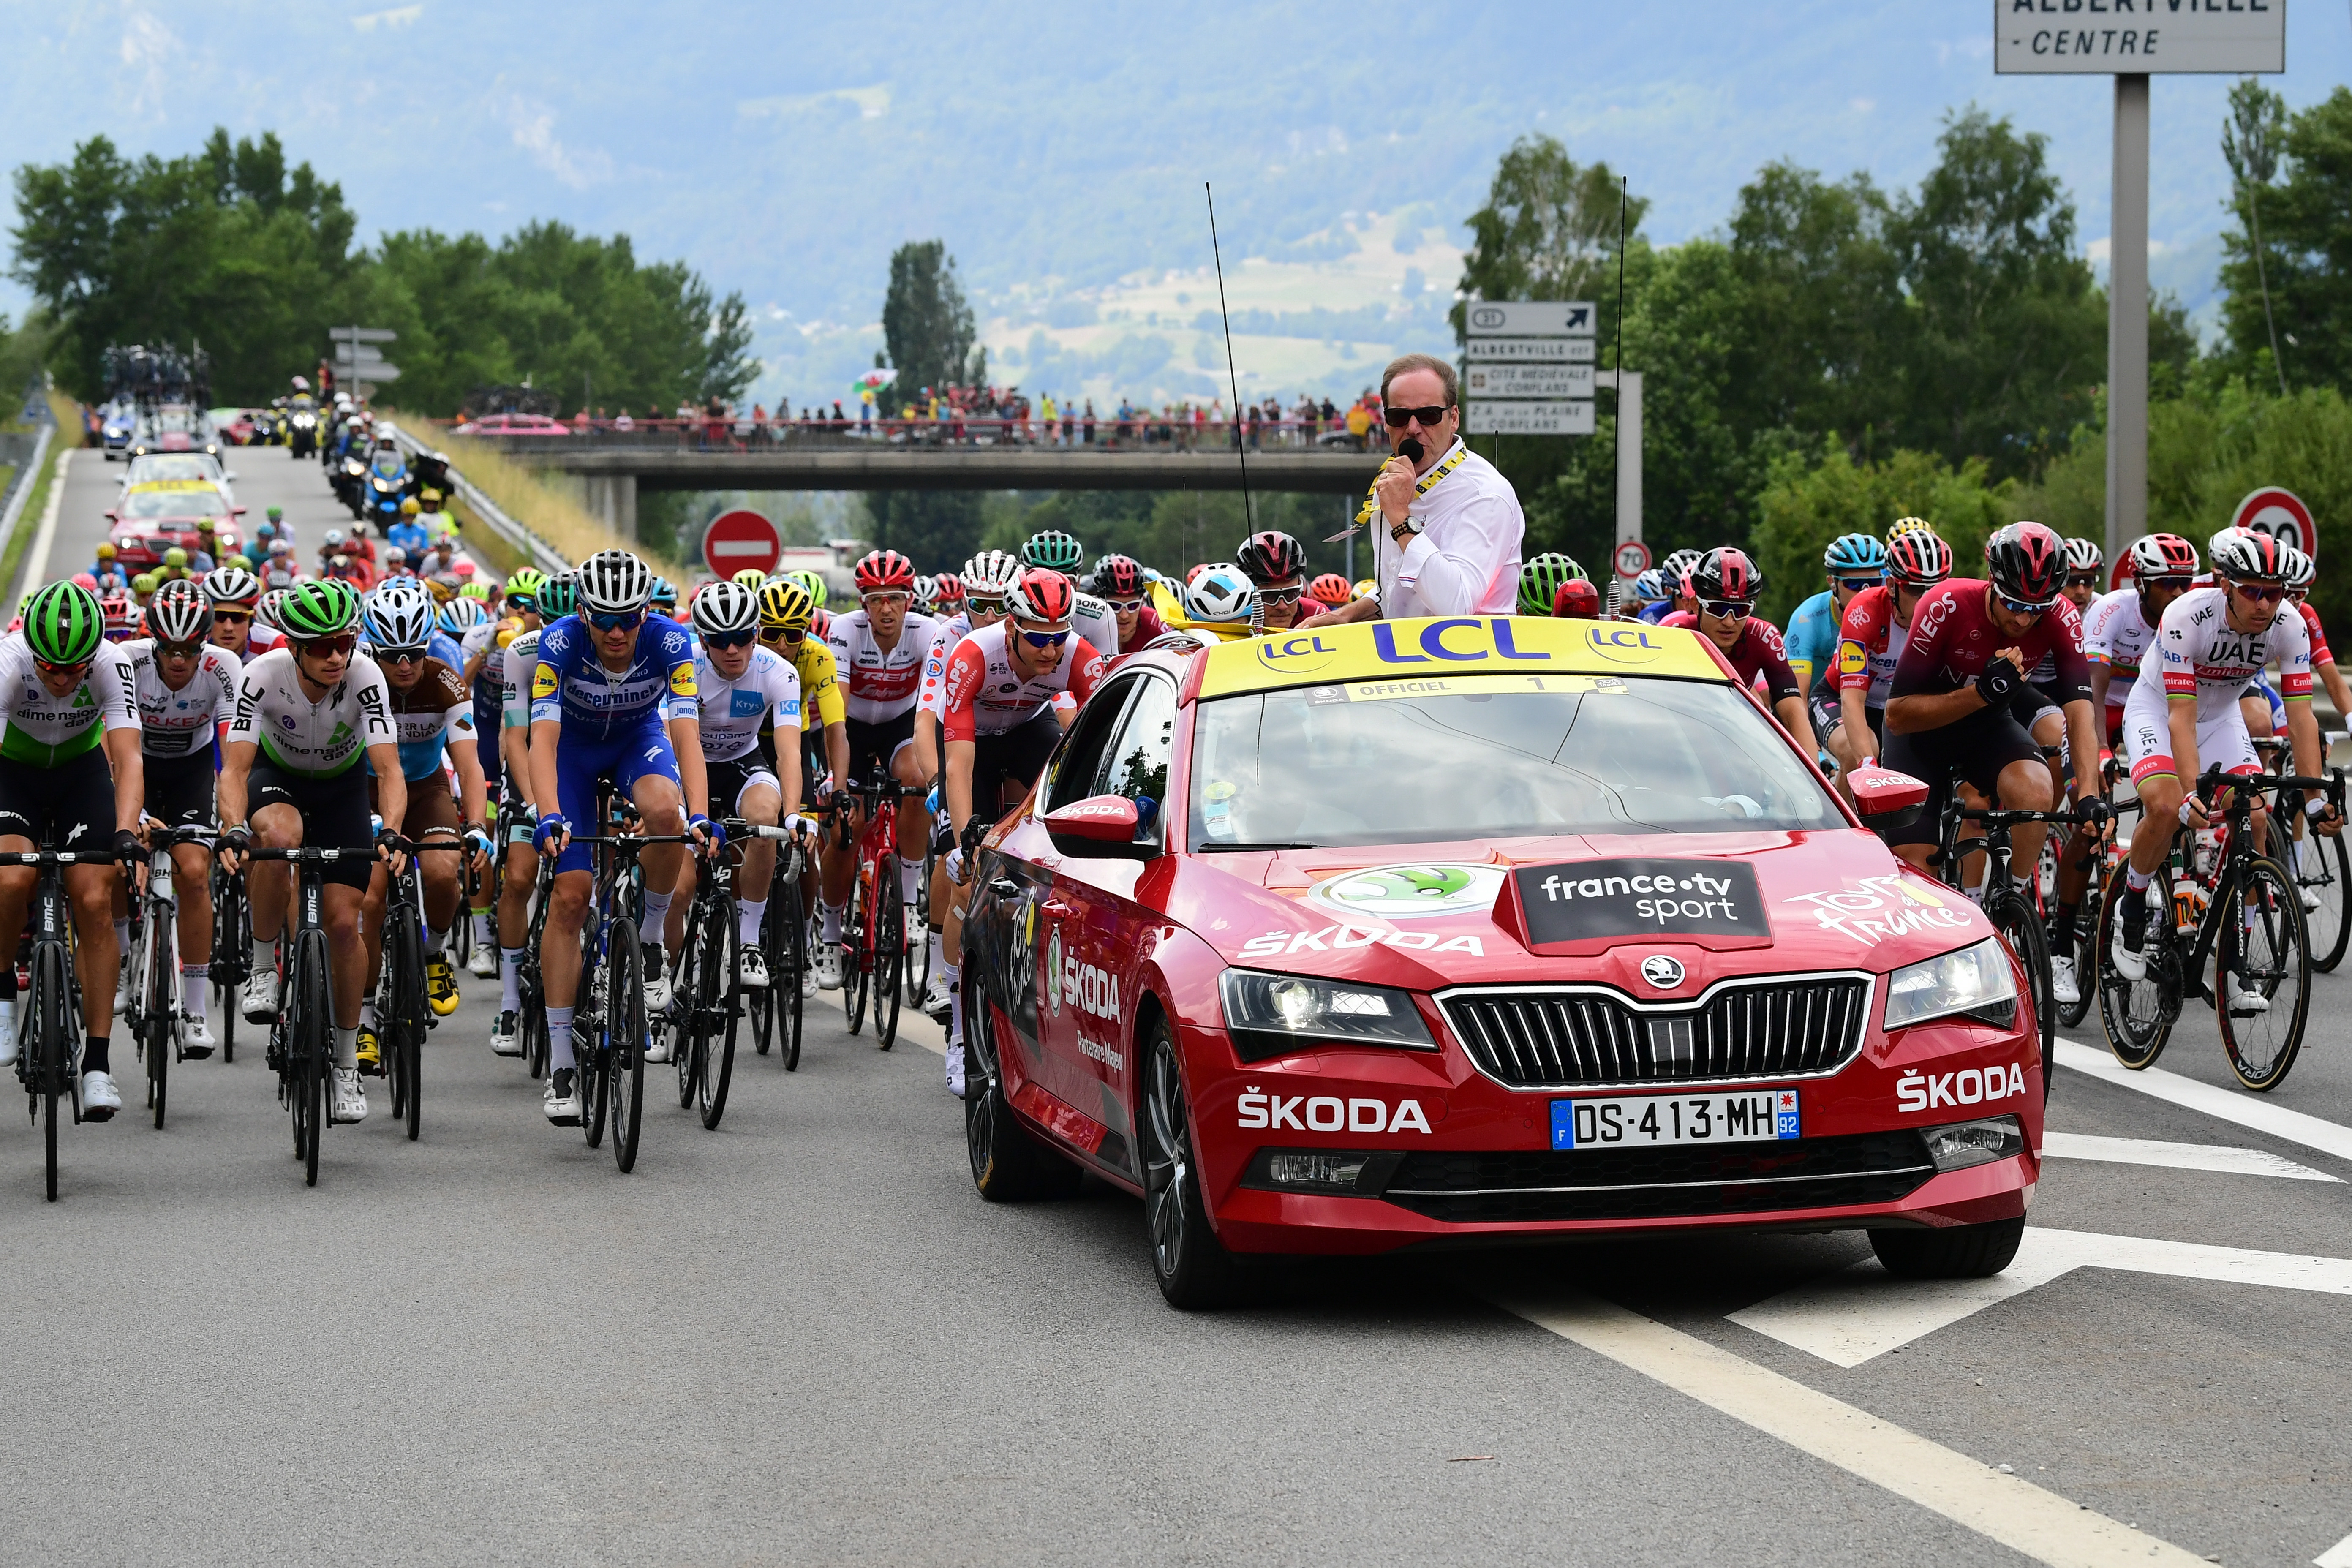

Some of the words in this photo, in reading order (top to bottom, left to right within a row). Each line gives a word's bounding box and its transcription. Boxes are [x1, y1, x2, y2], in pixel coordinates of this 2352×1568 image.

[2032, 30, 2159, 54] CENTRE
[1623, 552, 1644, 567] 70
[1912, 591, 1957, 657] INEOS
[2050, 597, 2085, 654] INEOS
[2092, 602, 2120, 636] Cofidis
[2191, 605, 2214, 626] UAE
[1263, 636, 1337, 659] LCL
[1371, 618, 1552, 663] LCL
[1591, 628, 1662, 650] LCL
[1750, 620, 1788, 661] INEOS
[756, 653, 774, 665] Krys
[2209, 642, 2265, 665] UAE
[817, 675, 837, 691] LCL
[1359, 681, 1451, 695] OFFICIEL
[1527, 677, 1545, 690] 1
[566, 684, 658, 708] deceuninck
[736, 700, 760, 711] Krys
[16, 708, 99, 721] dimension
[272, 732, 357, 755] dimension
[2138, 725, 2157, 746] UAE
[322, 740, 358, 762] data
[1866, 776, 1927, 789] ŠKODA
[1057, 805, 1126, 818] ŠKODA
[44, 896, 54, 932] BMC
[308, 889, 318, 924] BMC
[1637, 898, 1738, 926] sport
[1236, 924, 1485, 959] ŠKODA
[1065, 945, 1121, 1024] ŠKODA
[1077, 1029, 1105, 1064] Partenaire
[1105, 1040, 1123, 1073] Majeur
[1897, 1062, 2026, 1112] ŠKODA
[1238, 1086, 1432, 1134] ŠKODA
[1559, 1130, 1565, 1142] F
[1575, 1097, 1774, 1144] DS-413-MH
[1779, 1116, 1797, 1133] 92
